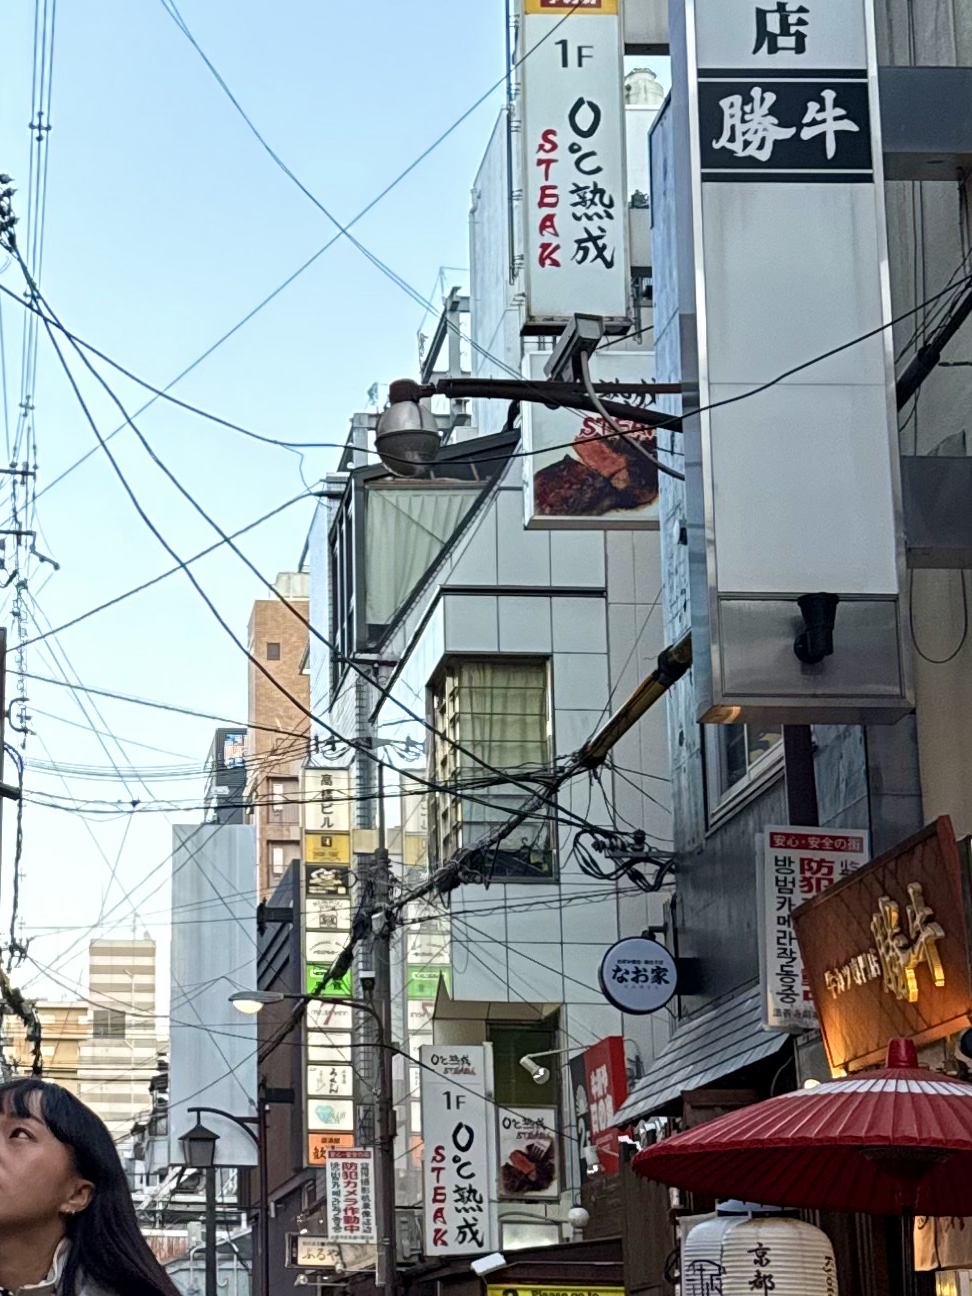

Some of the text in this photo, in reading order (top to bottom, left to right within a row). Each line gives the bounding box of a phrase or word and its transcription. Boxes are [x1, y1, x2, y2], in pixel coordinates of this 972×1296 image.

[554, 39, 594, 68] 1F
[752, 1, 810, 55] 店
[712, 86, 860, 162] 勝牛
[536, 129, 561, 268] STEAK
[611, 964, 670, 984] なお家
[443, 1091, 466, 1110] 1F
[341, 1162, 360, 1234] 防犯カメラ作動中
[431, 1145, 448, 1248] STEAK
